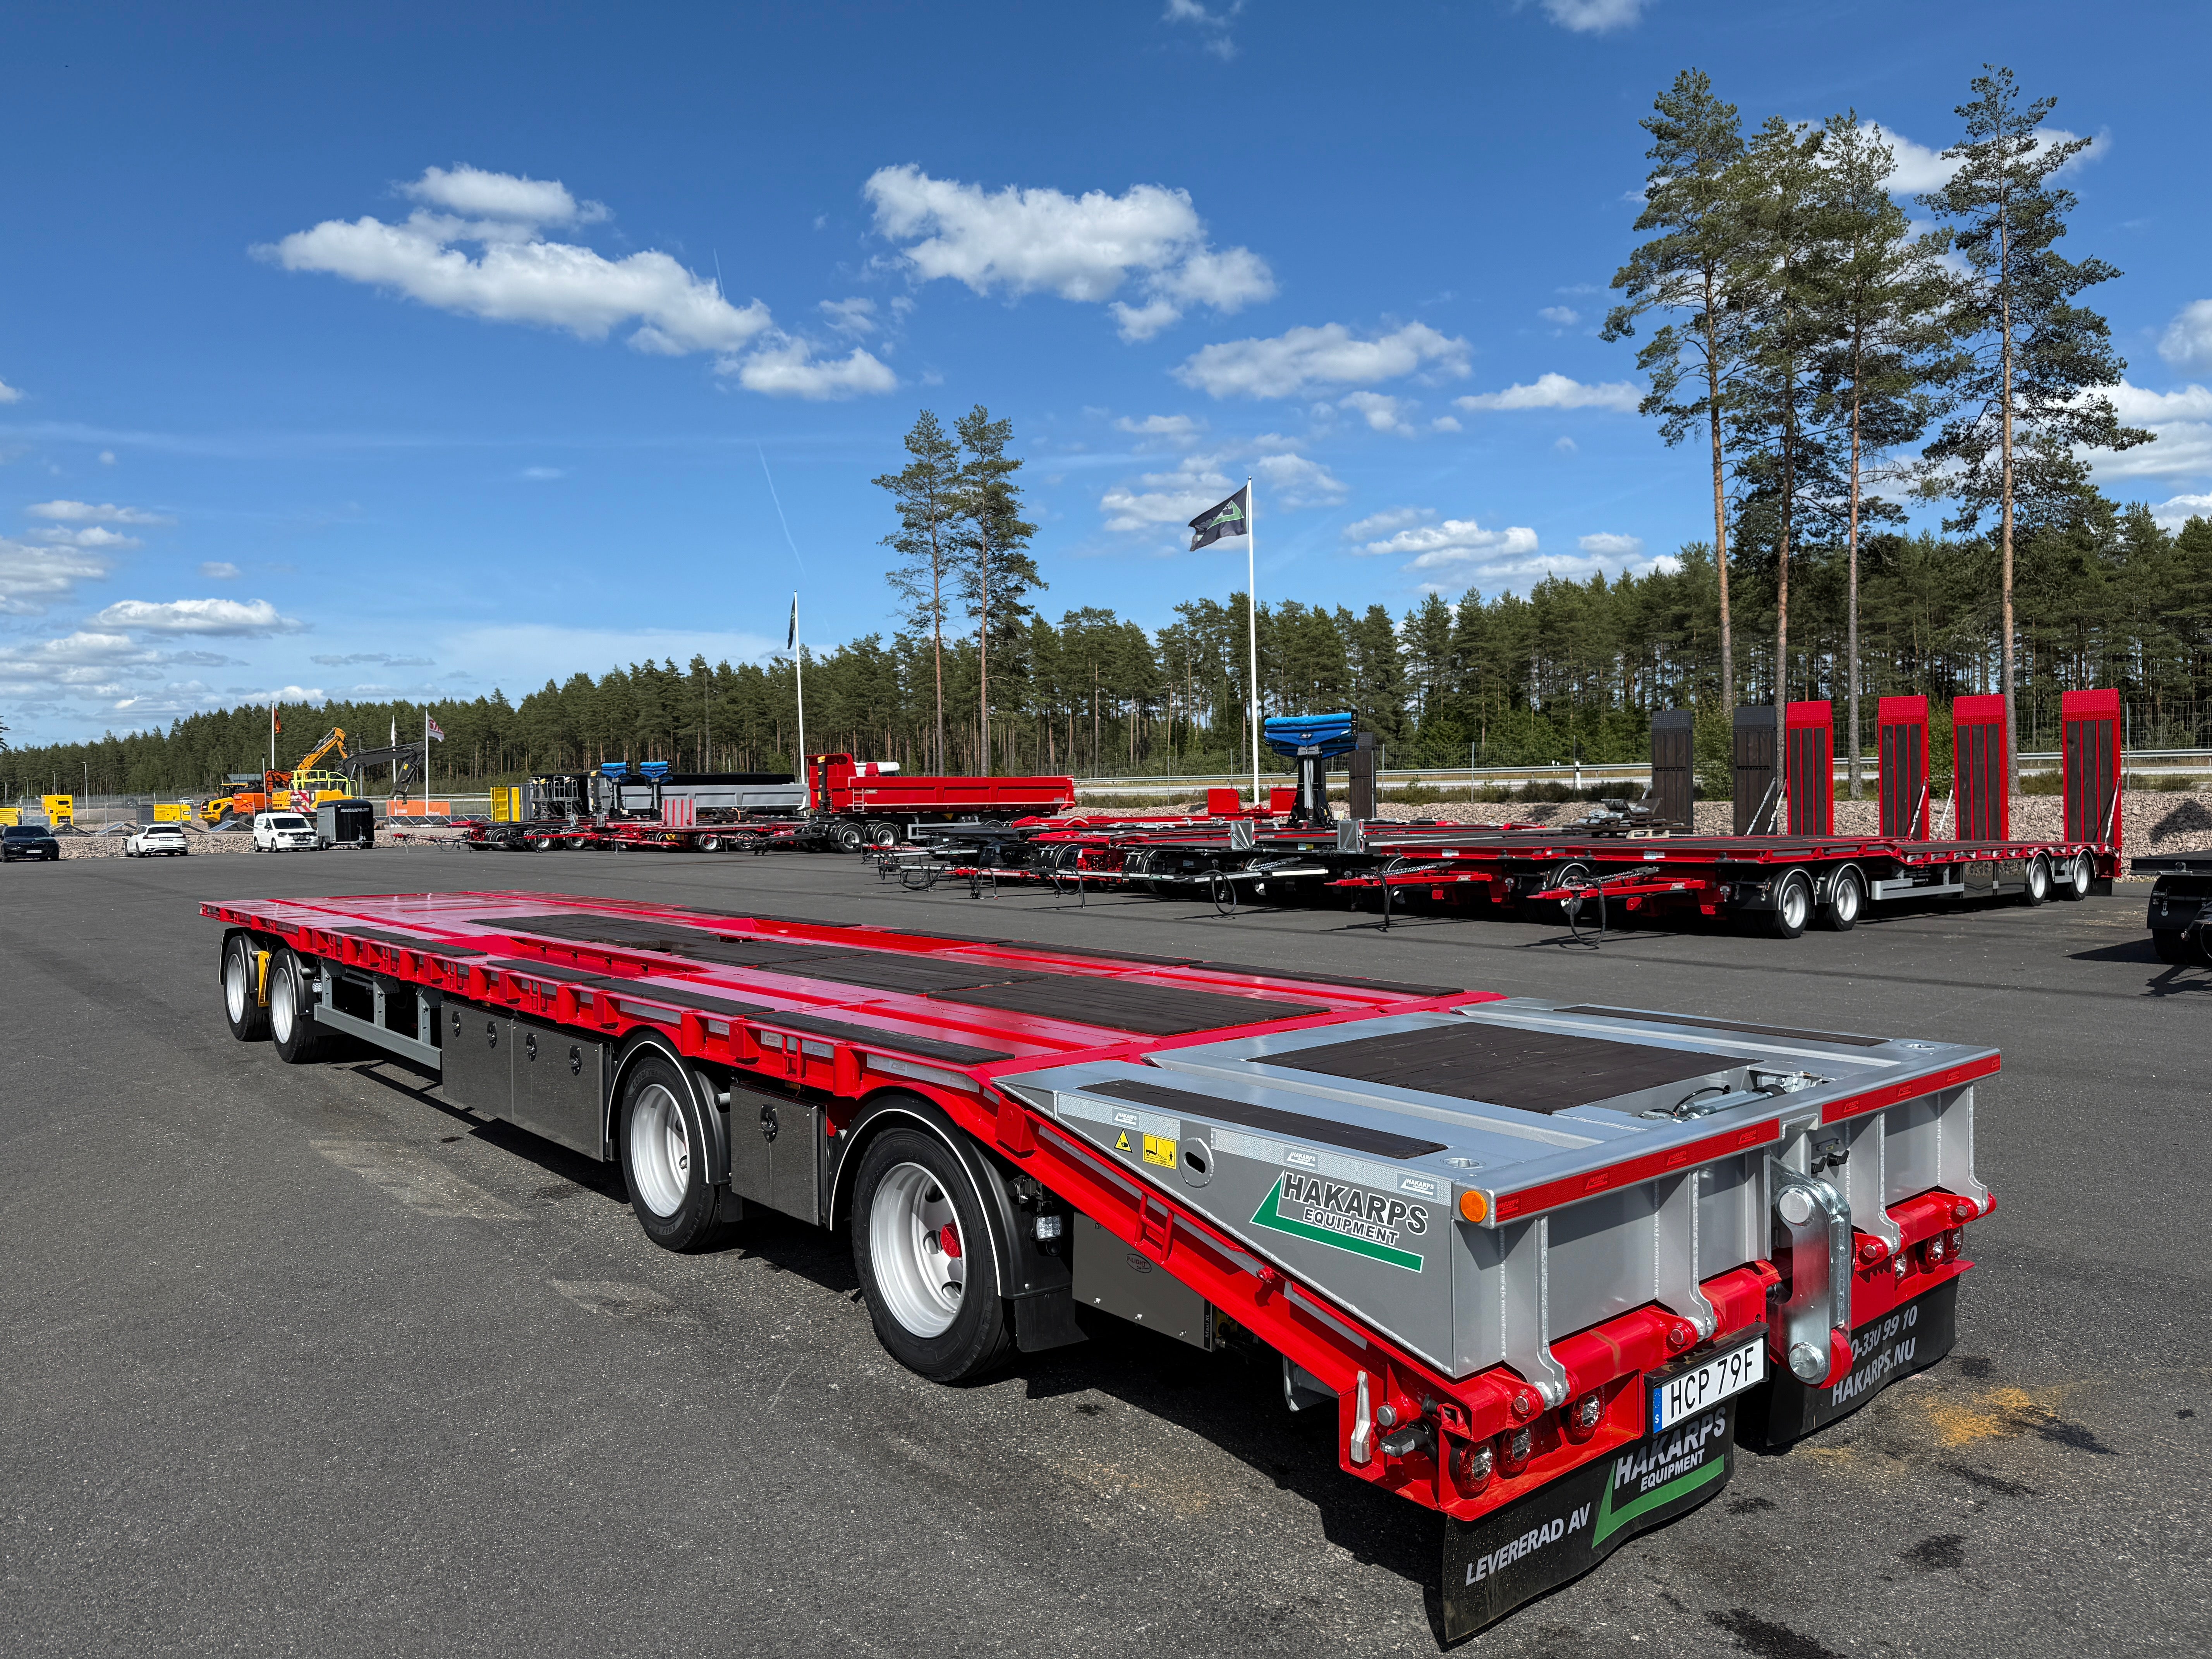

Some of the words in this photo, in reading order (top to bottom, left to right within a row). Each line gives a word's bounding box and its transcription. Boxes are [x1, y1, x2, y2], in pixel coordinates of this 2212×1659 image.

[1292, 1152, 1316, 1161] HAKARPS
[1282, 1172, 1428, 1235] HAKARPS
[1407, 1178, 1434, 1190] HAKARPS
[1304, 1207, 1399, 1245] EQUIPMENT
[1882, 1315, 1899, 1340] 99
[1903, 1305, 1917, 1330] 10
[1671, 1369, 1709, 1419] HCP
[1717, 1346, 1754, 1395] 79F
[1832, 1337, 1916, 1407] HAKARPS.NU
[1655, 1414, 1659, 1424] S
[1614, 1407, 1726, 1490] HAKARPS
[1640, 1448, 1705, 1492] EQUIPMENT
[1465, 1518, 1564, 1586] LEVERERAD
[1567, 1502, 1591, 1534] AV
